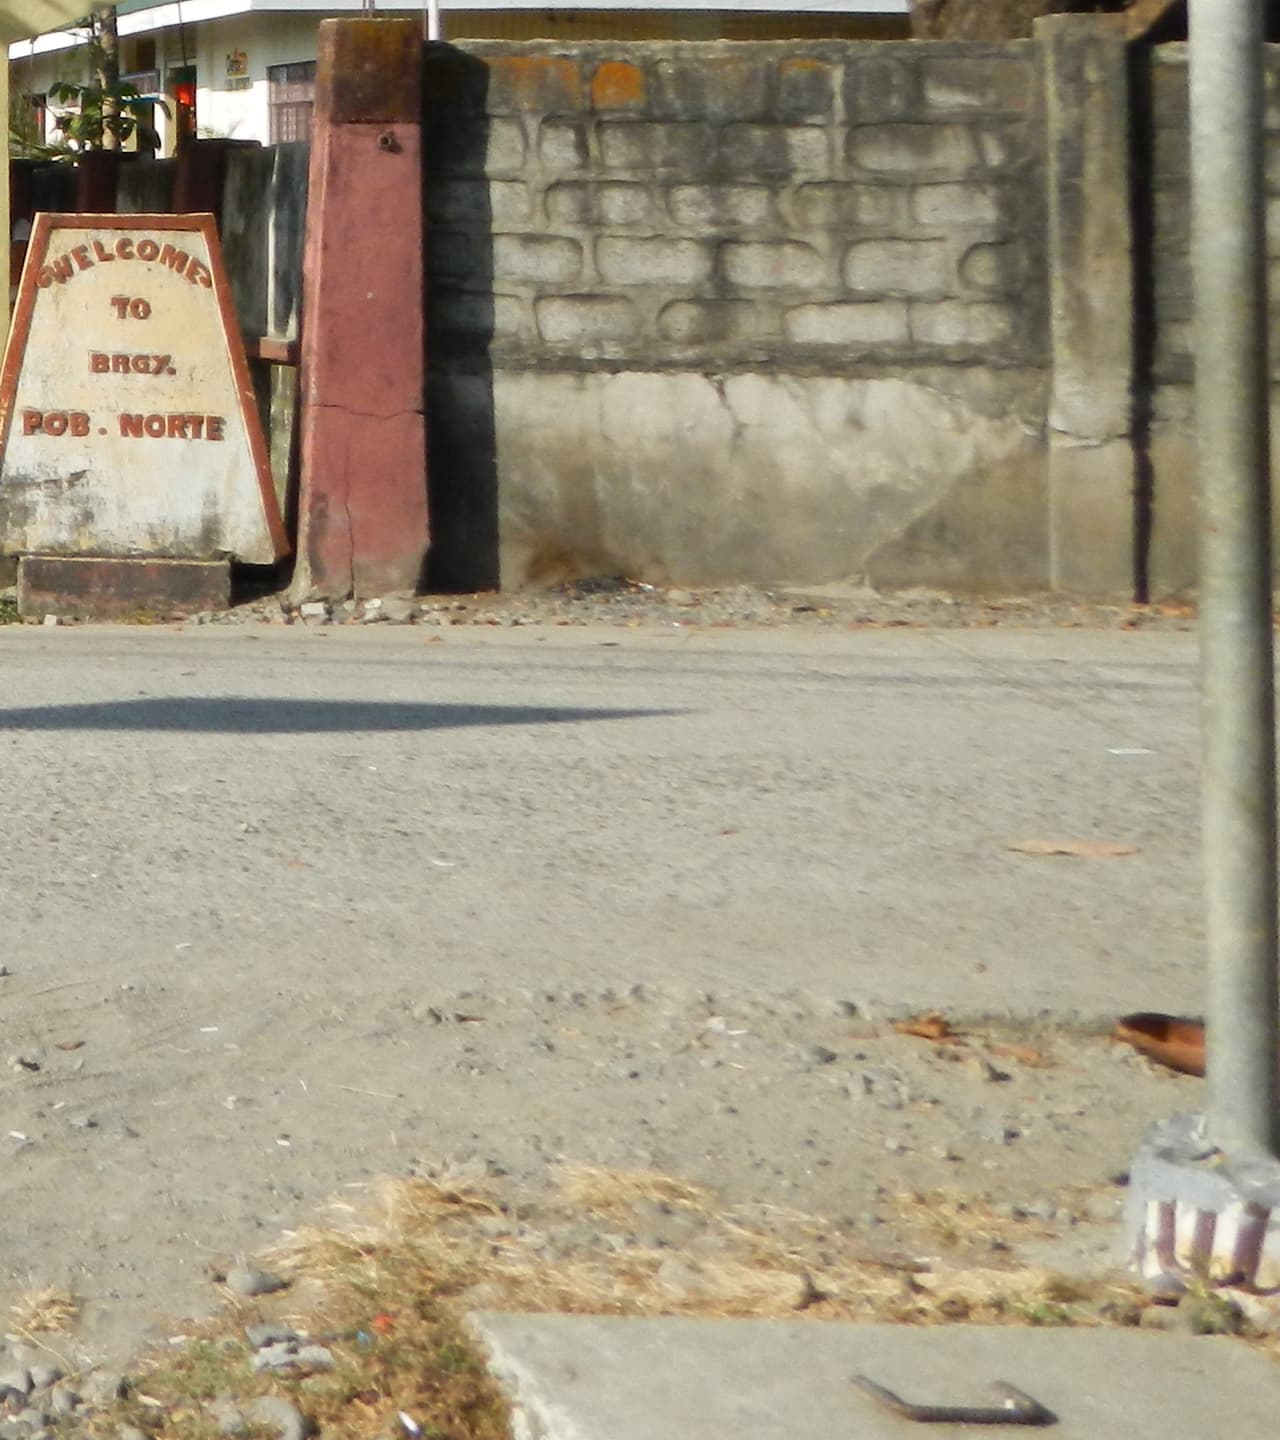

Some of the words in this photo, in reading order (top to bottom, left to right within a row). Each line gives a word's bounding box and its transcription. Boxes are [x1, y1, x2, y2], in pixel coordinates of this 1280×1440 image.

[35, 238, 215, 289] WELCOME
[110, 295, 152, 320] TO
[89, 353, 177, 375] BRGY.
[119, 413, 226, 442] NORTE
